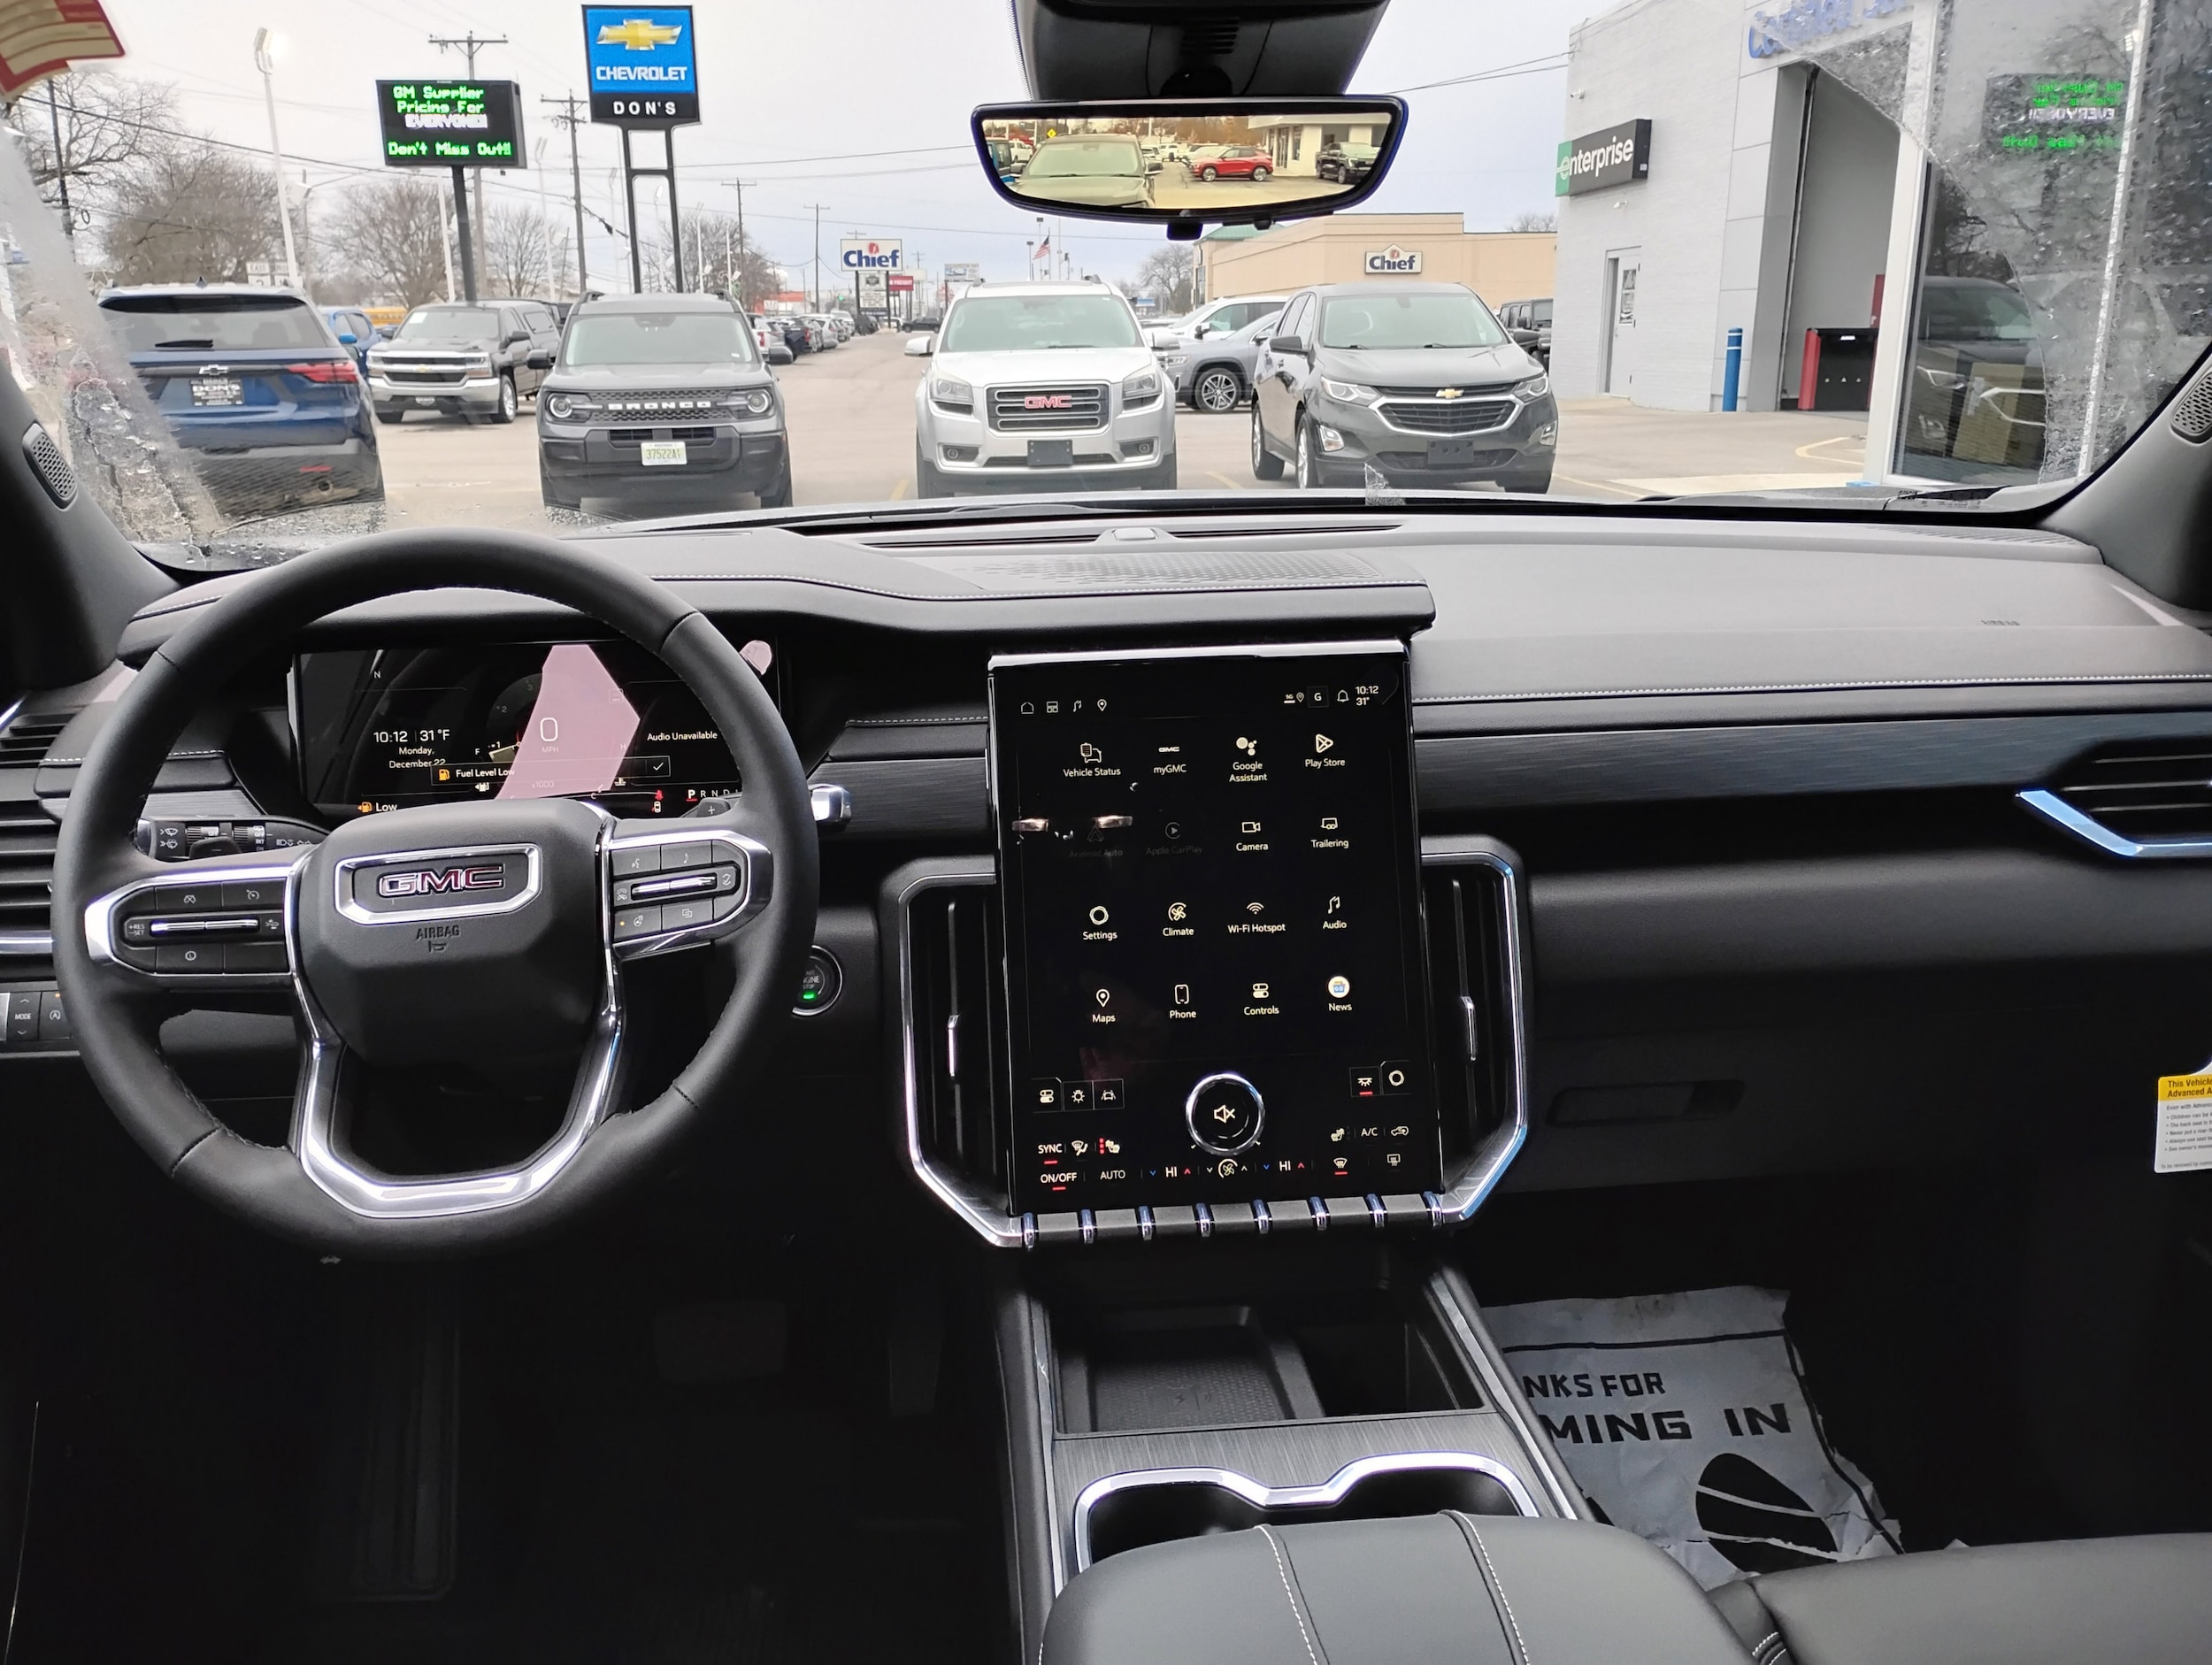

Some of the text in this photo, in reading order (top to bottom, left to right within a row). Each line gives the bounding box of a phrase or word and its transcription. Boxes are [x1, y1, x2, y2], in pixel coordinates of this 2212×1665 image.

[595, 65, 687, 81] CHEVROLET
[393, 86, 416, 99] GM
[457, 100, 484, 113] For
[613, 101, 676, 115] DON'S
[388, 142, 427, 156] Don't
[435, 142, 470, 156] Miss
[1556, 135, 1634, 180] enterprise
[843, 249, 900, 267] Chief
[1369, 253, 1416, 270] Chief
[1024, 395, 1072, 409] GMC
[1355, 685, 1379, 694] 10:12
[1314, 692, 1322, 702] G
[373, 731, 408, 743] 10:12
[646, 731, 718, 741] Audio Unavailable
[388, 758, 433, 769] December
[1153, 763, 1187, 775] myGMC
[1233, 761, 1263, 772] Google
[1304, 758, 1346, 769] Play Store
[456, 768, 515, 778] Fuel Level Low
[1063, 766, 1121, 778] Vehicle Status
[1229, 773, 1268, 783] Assistant
[375, 802, 397, 813] Low
[1235, 842, 1269, 852] Camera
[1310, 839, 1349, 848] Trailering
[1103, 848, 1124, 857] Auto
[1146, 846, 1203, 856] Apple CarPlay
[379, 864, 505, 897] GMC
[1227, 923, 1286, 933] Wi-Fi Hotspot
[1323, 920, 1348, 930] Audio
[416, 925, 460, 940] AIRBAG
[1082, 931, 1118, 941] Settings
[1162, 927, 1194, 937] Climate
[1243, 1005, 1280, 1016] Controls
[1328, 1002, 1353, 1012] News
[1092, 1014, 1116, 1024] Maps
[1169, 1009, 1197, 1019] Phone
[2168, 1079, 2184, 1088] This
[2167, 1087, 2205, 1097] Advanced
[1361, 1127, 1379, 1138] A/C
[1037, 1143, 1063, 1155] SYNC
[1279, 1160, 1292, 1172] HI
[1100, 1170, 1126, 1180] AUTO
[1165, 1166, 1178, 1178] HI
[1040, 1172, 1078, 1184] ON/OFF
[1600, 1372, 1666, 1397] FOR
[1723, 1402, 1792, 1438] IN
